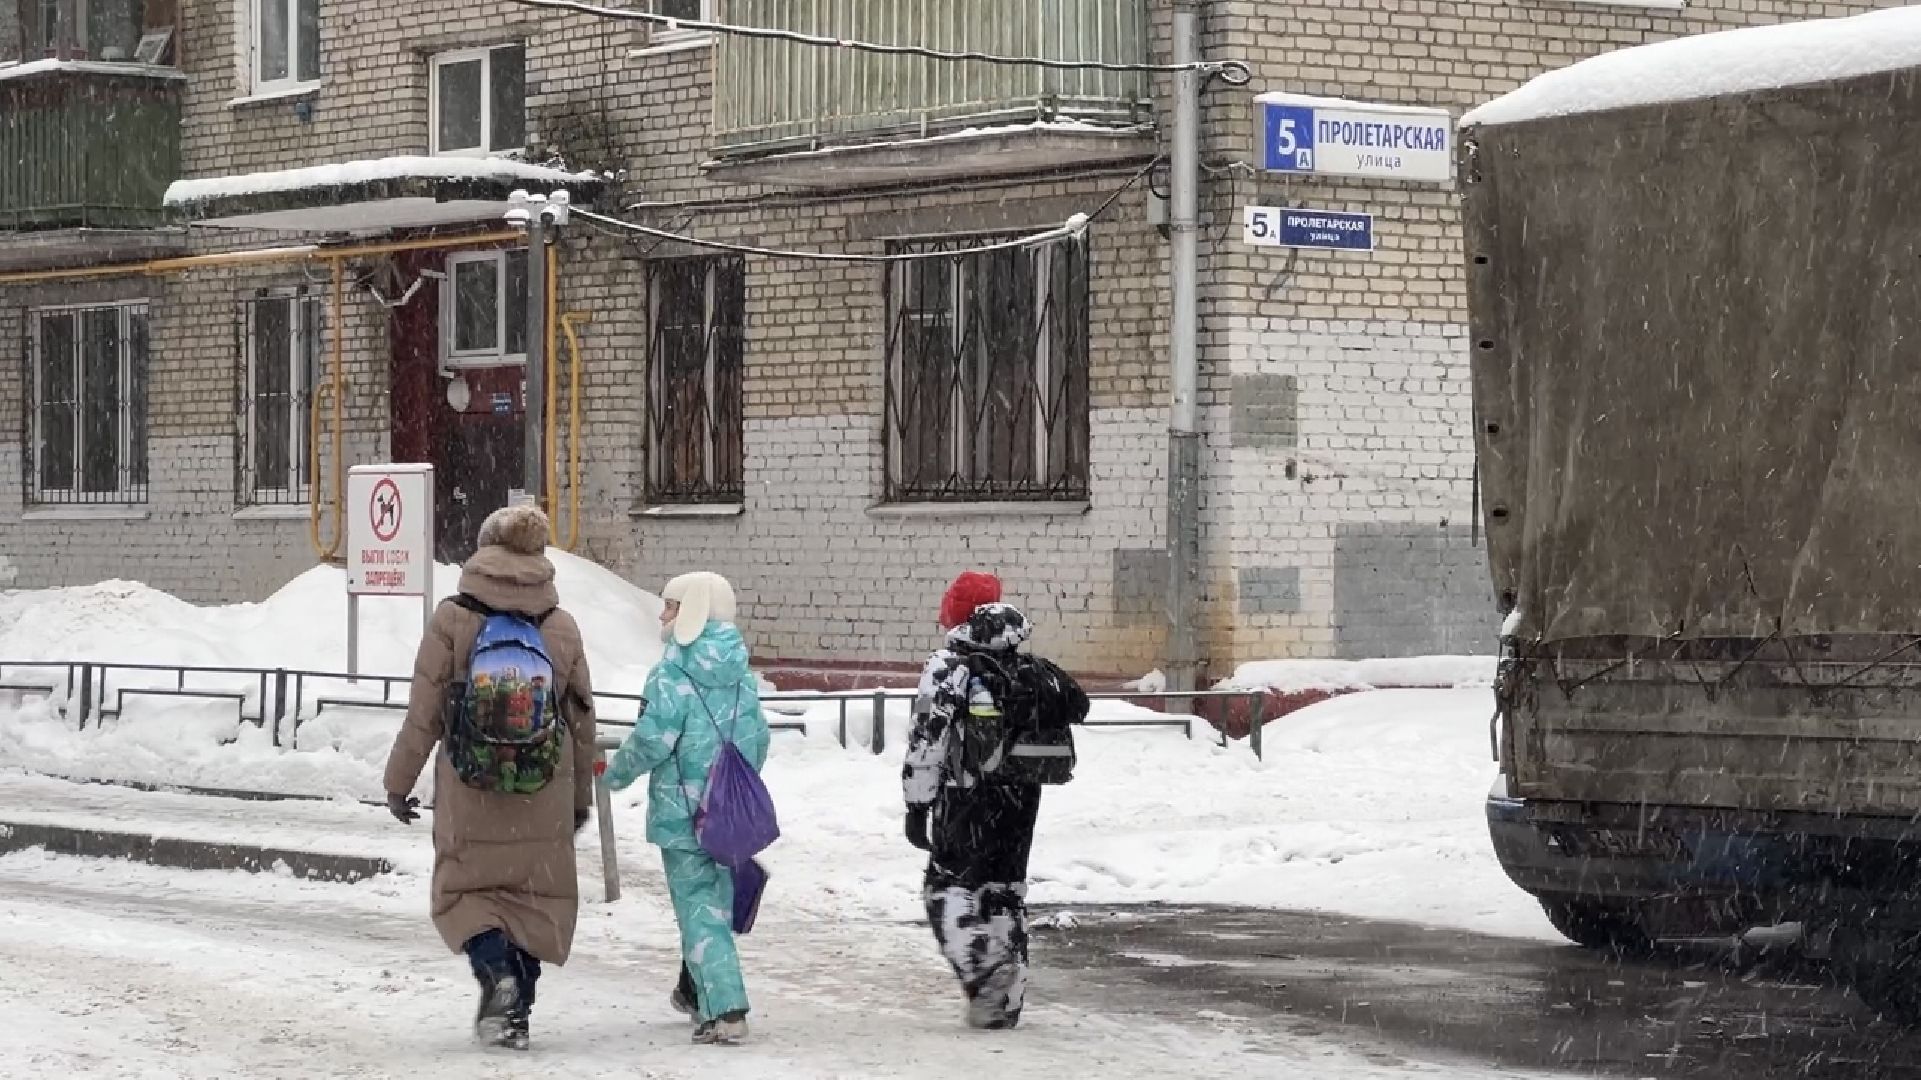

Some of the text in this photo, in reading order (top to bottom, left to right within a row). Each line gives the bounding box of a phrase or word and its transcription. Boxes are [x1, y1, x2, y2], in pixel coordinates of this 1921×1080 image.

[1278, 118, 1310, 167] 5 А
[1318, 120, 1444, 151] ПРОЛЕТАРСКАЯ
[1357, 154, 1401, 170] улица
[1252, 213, 1268, 238] 5
[1287, 216, 1365, 231] ПРОЛЕТАРСКАЯ
[1310, 232, 1340, 242] улица
